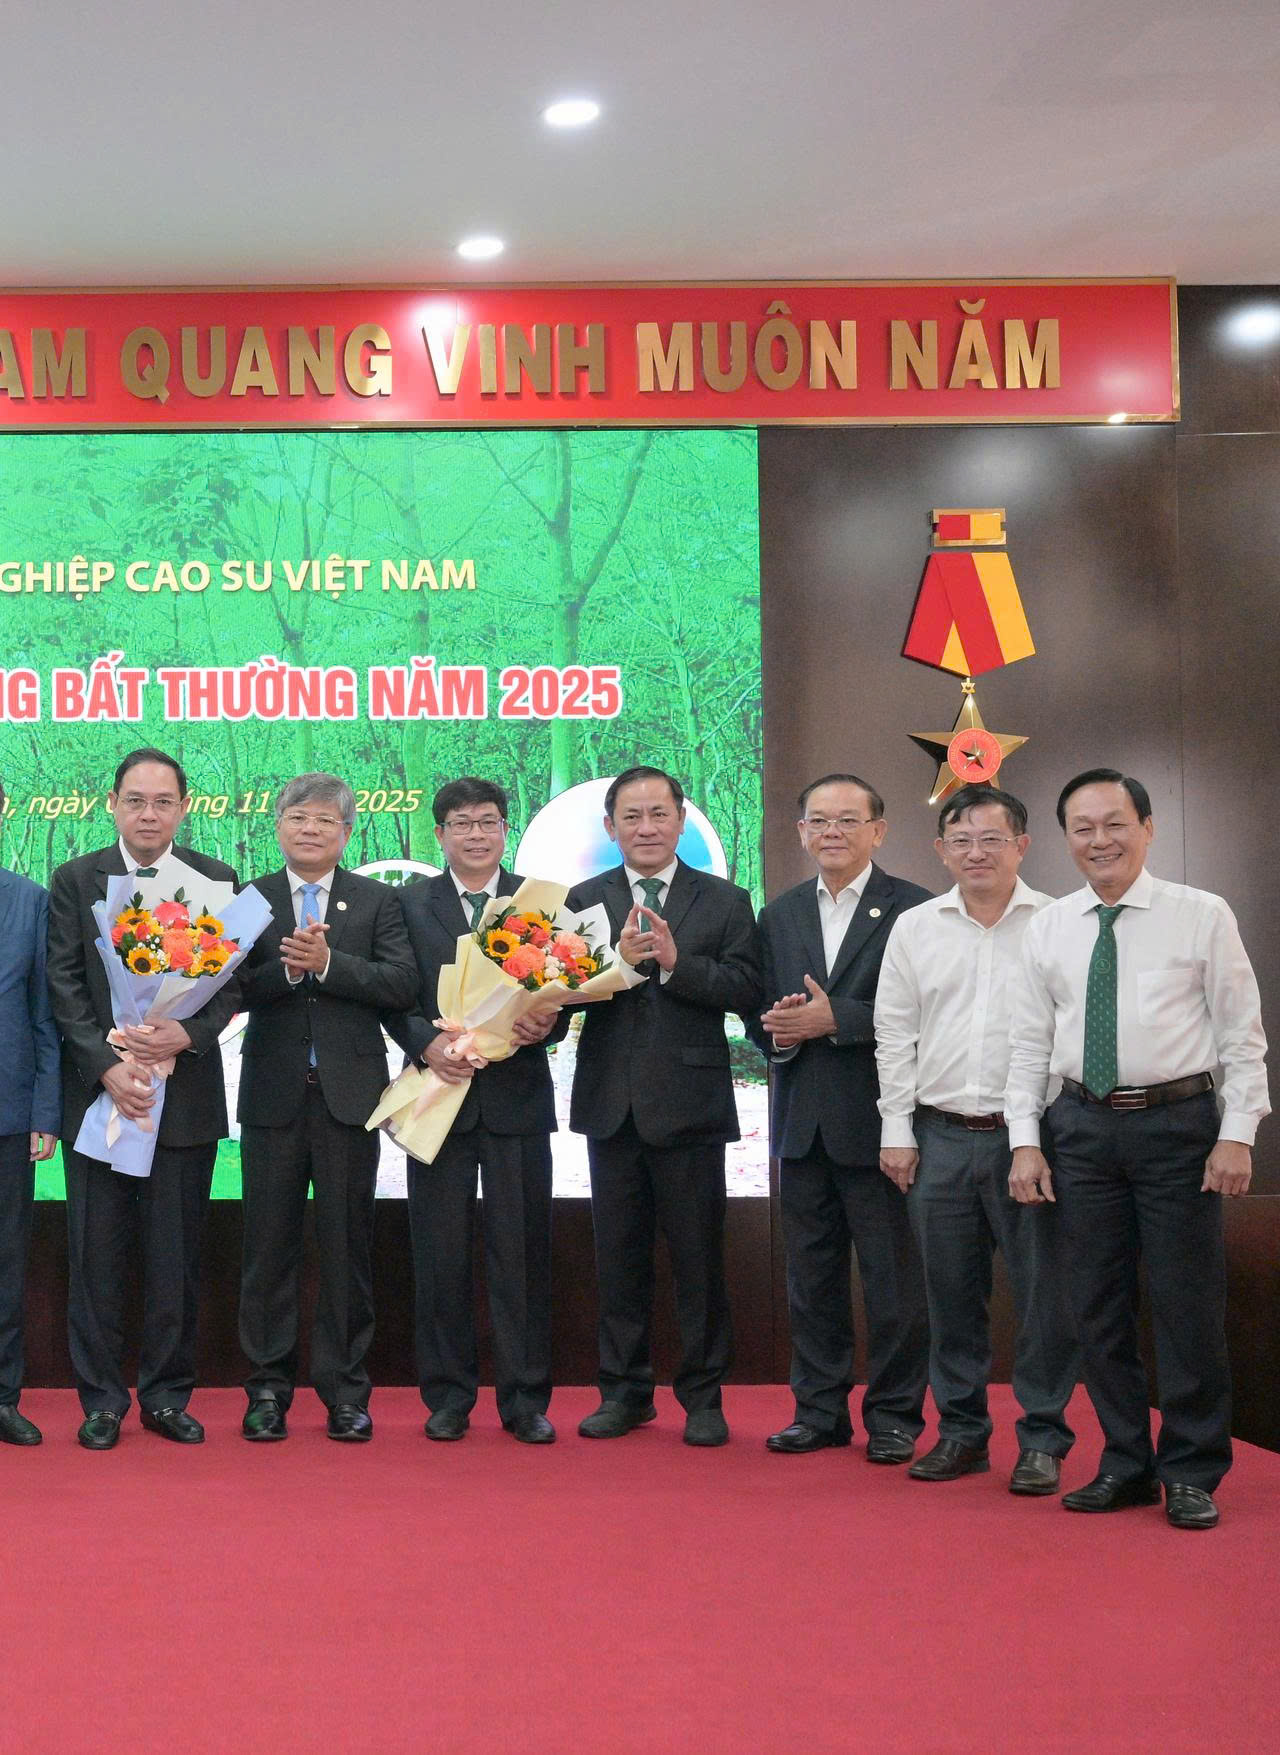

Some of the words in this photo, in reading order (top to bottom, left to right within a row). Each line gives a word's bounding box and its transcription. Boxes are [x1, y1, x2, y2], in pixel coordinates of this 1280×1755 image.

[122, 324, 393, 405] QUANG
[422, 323, 606, 396] VINH
[637, 302, 859, 394] MUÔN
[889, 299, 1061, 389] NĂM
[125, 560, 212, 592] CAO
[222, 560, 274, 592] SU
[282, 554, 372, 600] VIỆT
[383, 559, 477, 590] NAM
[54, 652, 148, 720] BẤT
[160, 658, 356, 720] THƯỜNG
[370, 659, 487, 719] NĂM
[500, 667, 623, 719] 2025
[28, 790, 97, 819] ngày
[238, 791, 269, 813] 11
[355, 789, 423, 813] 2025
